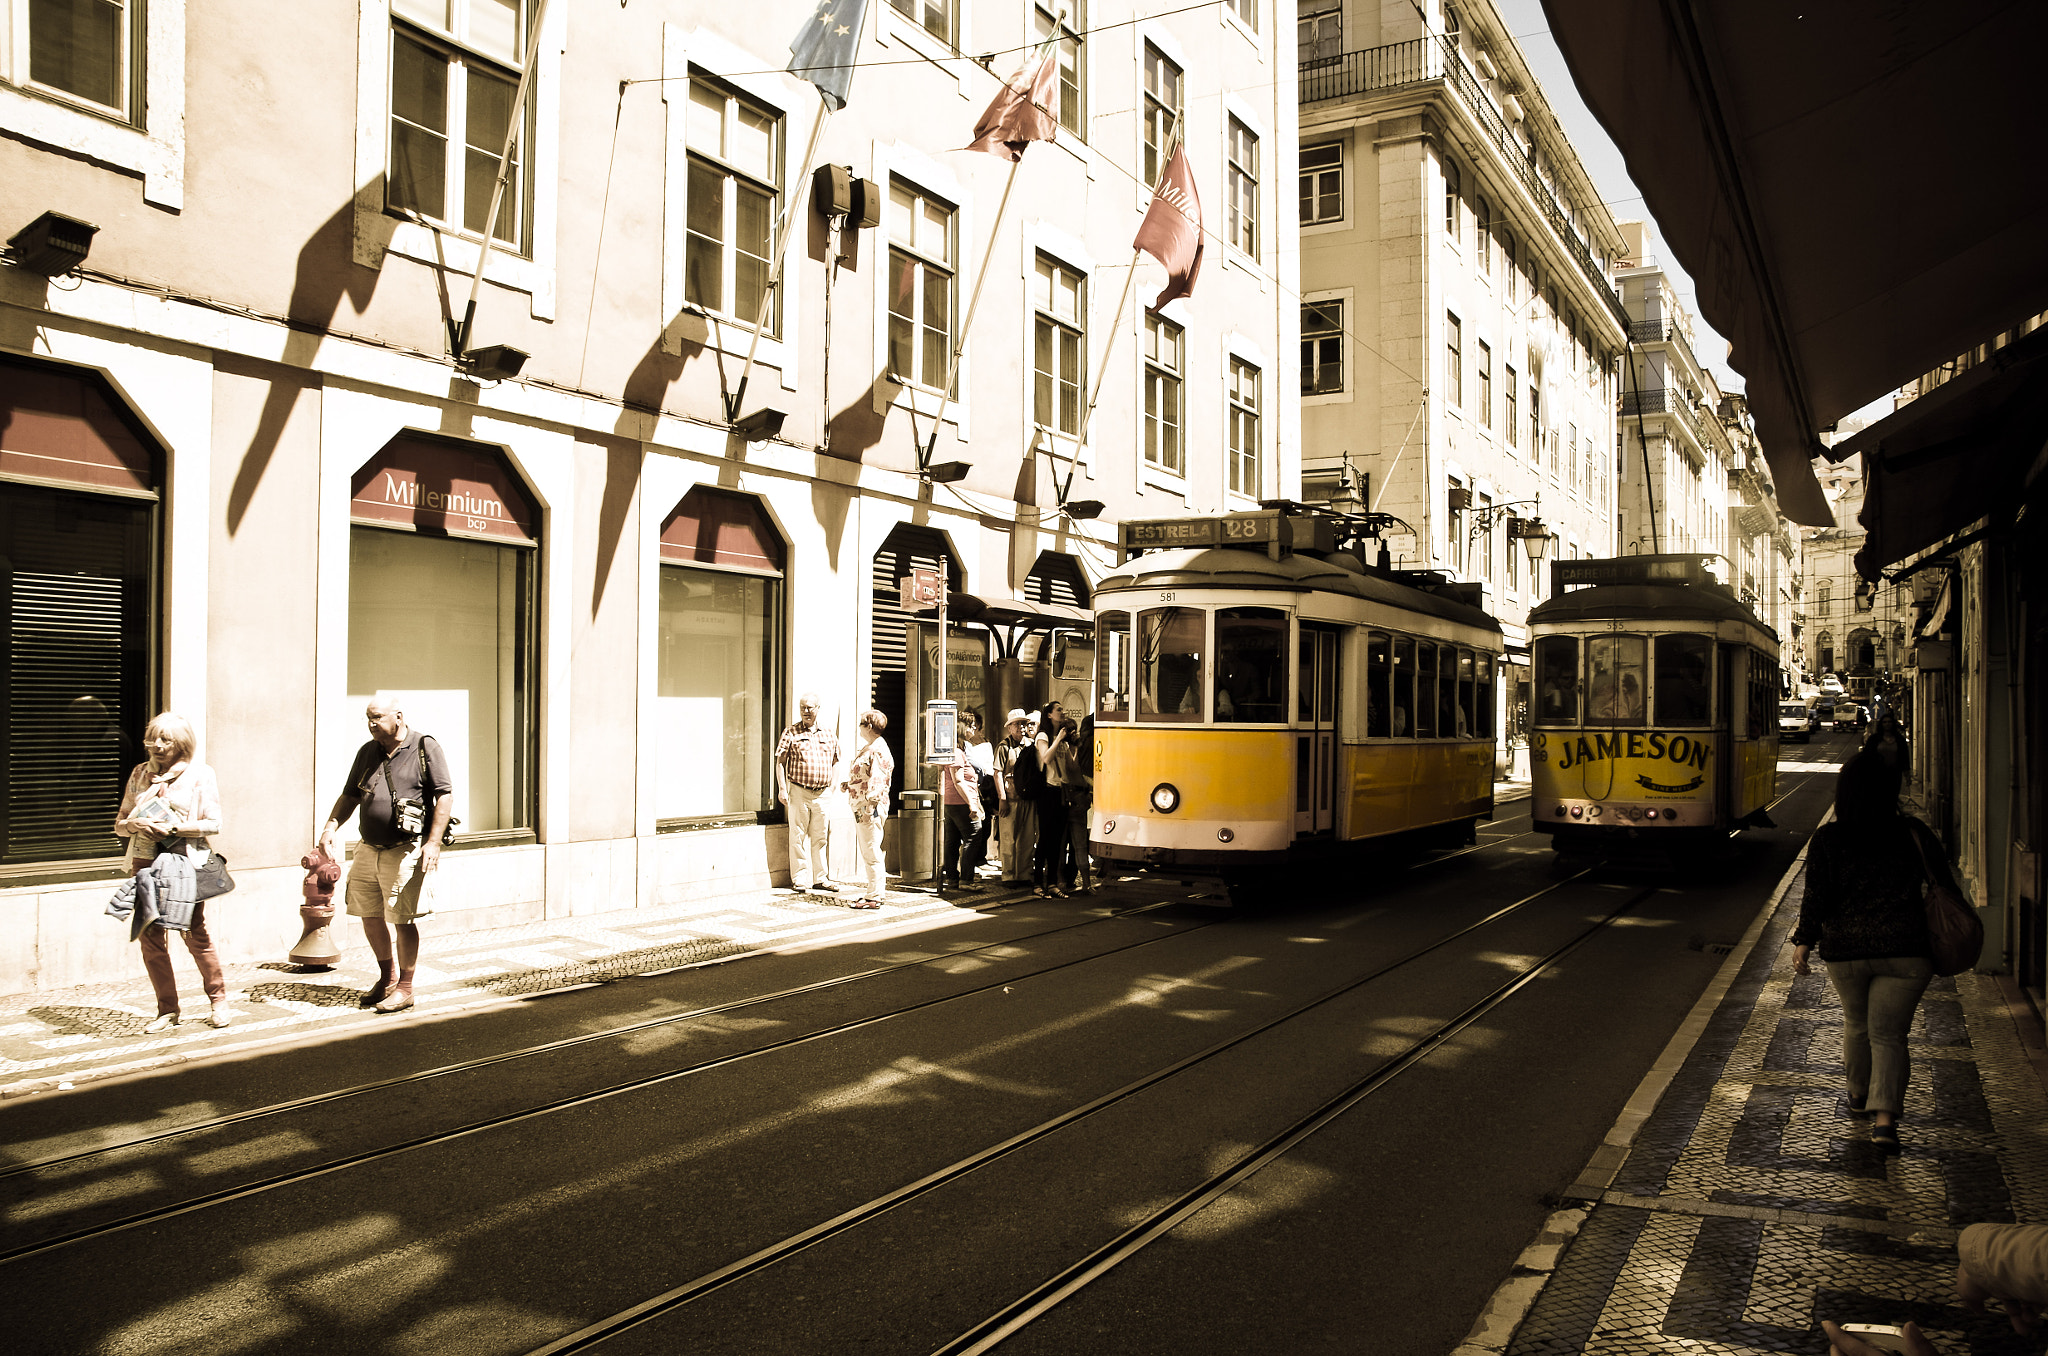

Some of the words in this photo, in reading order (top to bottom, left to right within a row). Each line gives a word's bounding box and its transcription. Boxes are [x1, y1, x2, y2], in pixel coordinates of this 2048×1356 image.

[385, 472, 502, 518] Millennium
[467, 516, 487, 532] bcp
[1134, 524, 1211, 539] ESTRELA
[1160, 592, 1176, 602] 581
[1559, 732, 1710, 770] JAMESON
